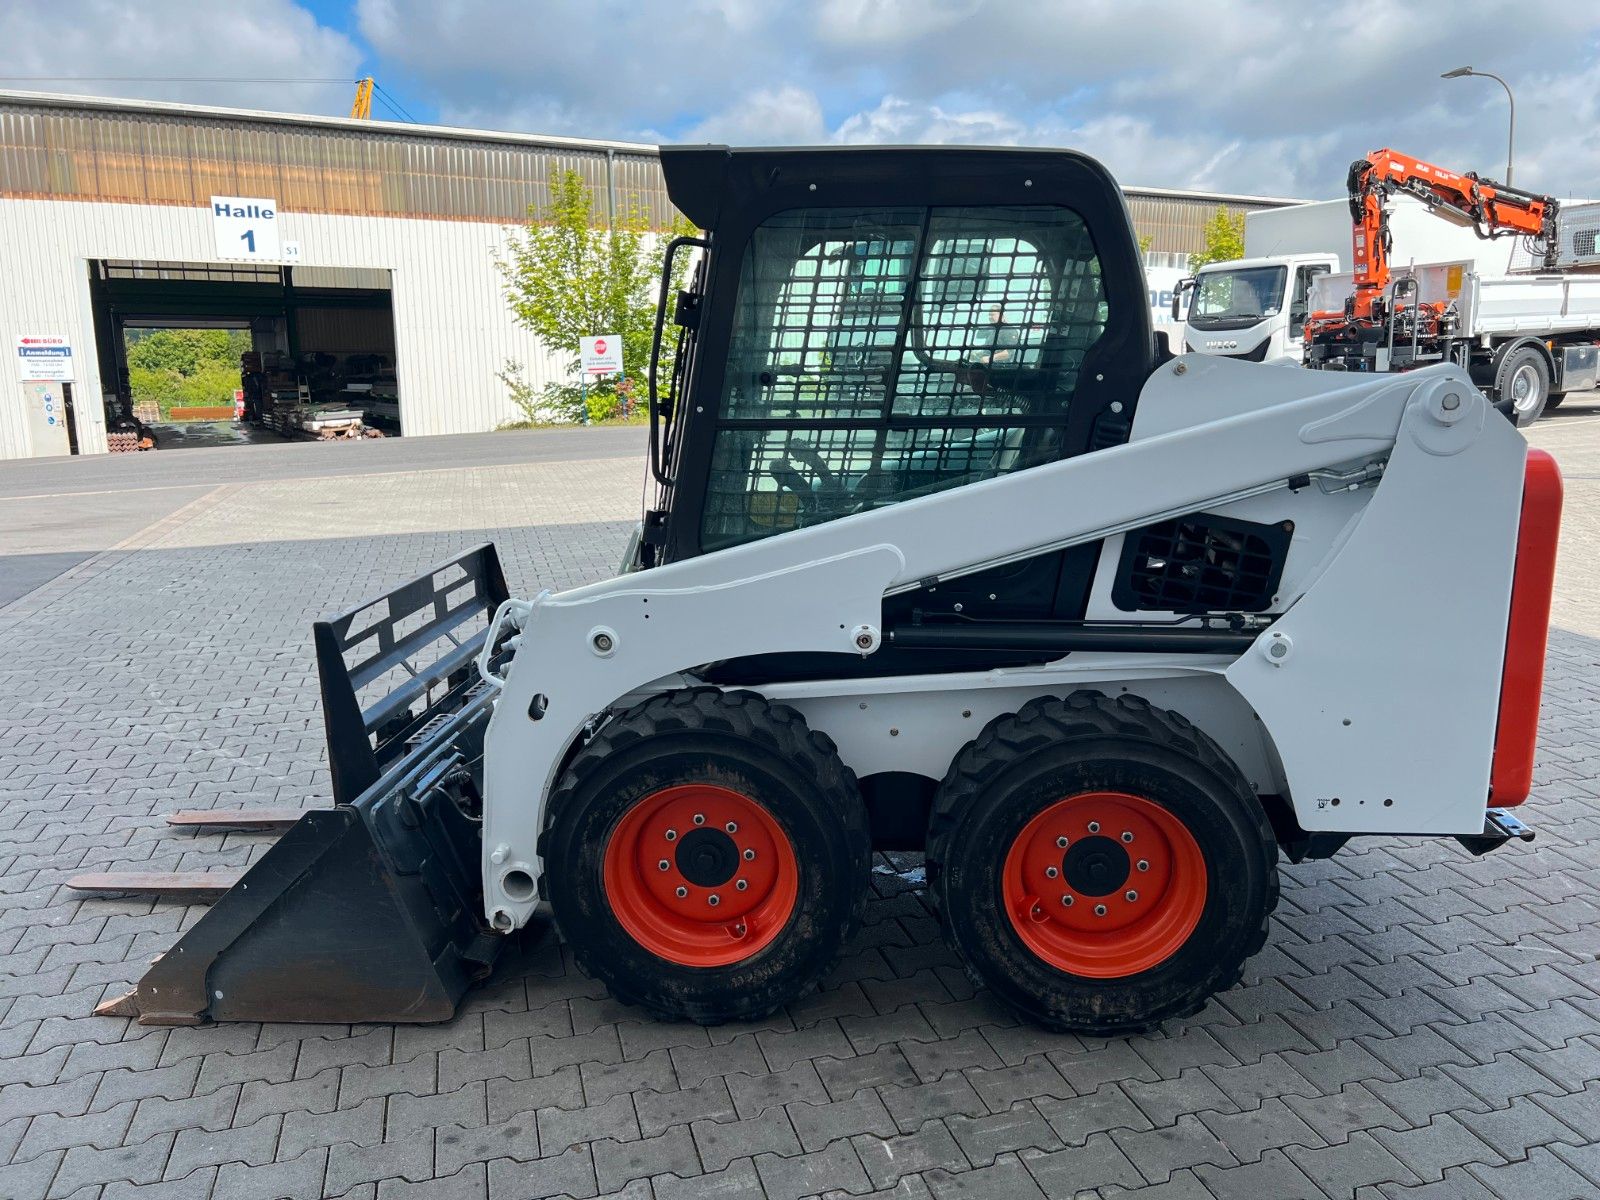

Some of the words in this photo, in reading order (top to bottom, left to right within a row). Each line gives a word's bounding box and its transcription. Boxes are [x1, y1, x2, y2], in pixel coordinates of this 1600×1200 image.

[214, 203, 274, 219] Halle
[240, 229, 256, 252] 1
[1206, 341, 1237, 349] IVECO
